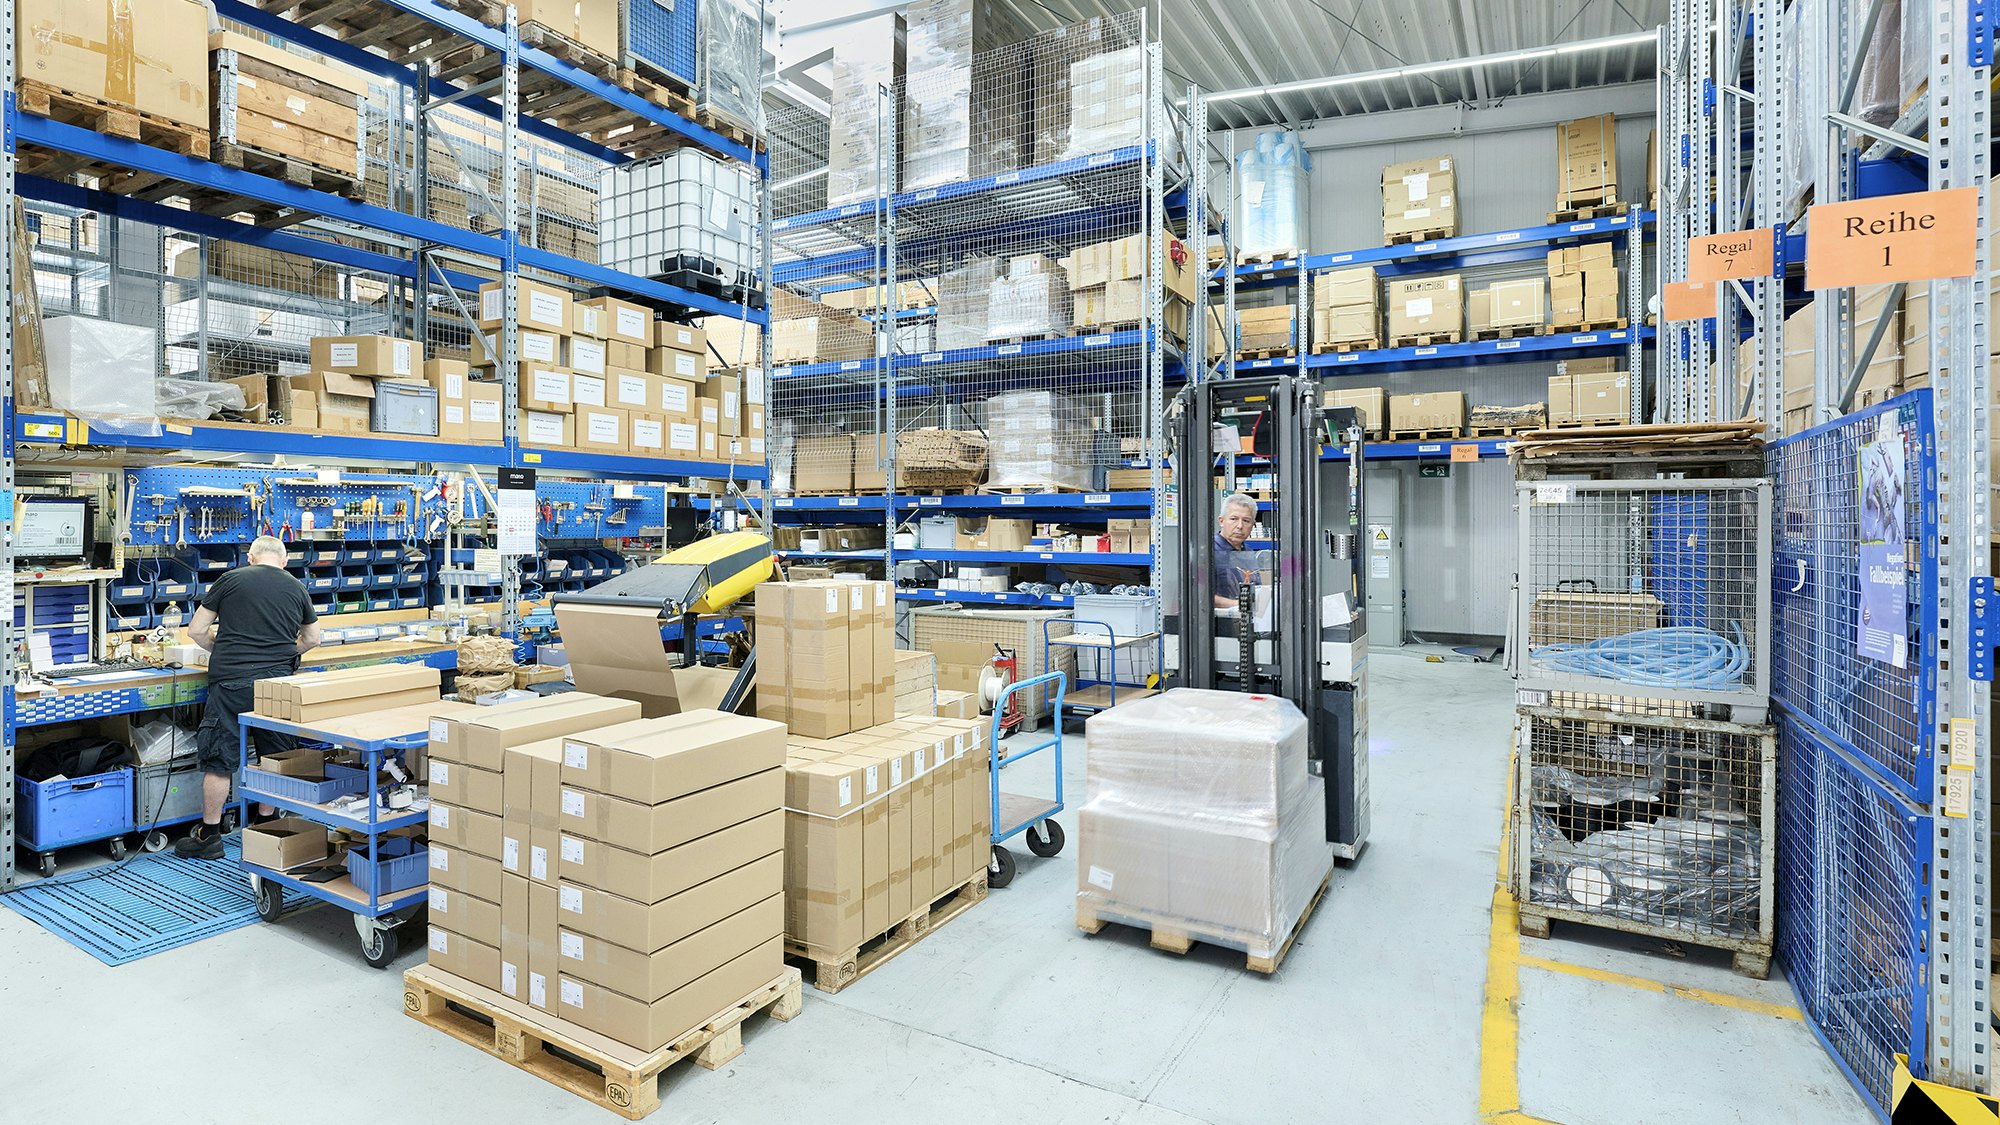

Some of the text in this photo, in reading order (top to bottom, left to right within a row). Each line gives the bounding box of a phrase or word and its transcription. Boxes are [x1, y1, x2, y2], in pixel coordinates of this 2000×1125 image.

[1842, 210, 1936, 239] Reihe
[1706, 238, 1752, 256] Regal
[1881, 246, 1893, 267] 1
[1724, 259, 1734, 271] 7
[1869, 565, 1905, 589] Fallbeispiel
[1954, 730, 1969, 763] 17920
[1949, 778, 1962, 812] 17925
[609, 1086, 627, 1105] EPAL
